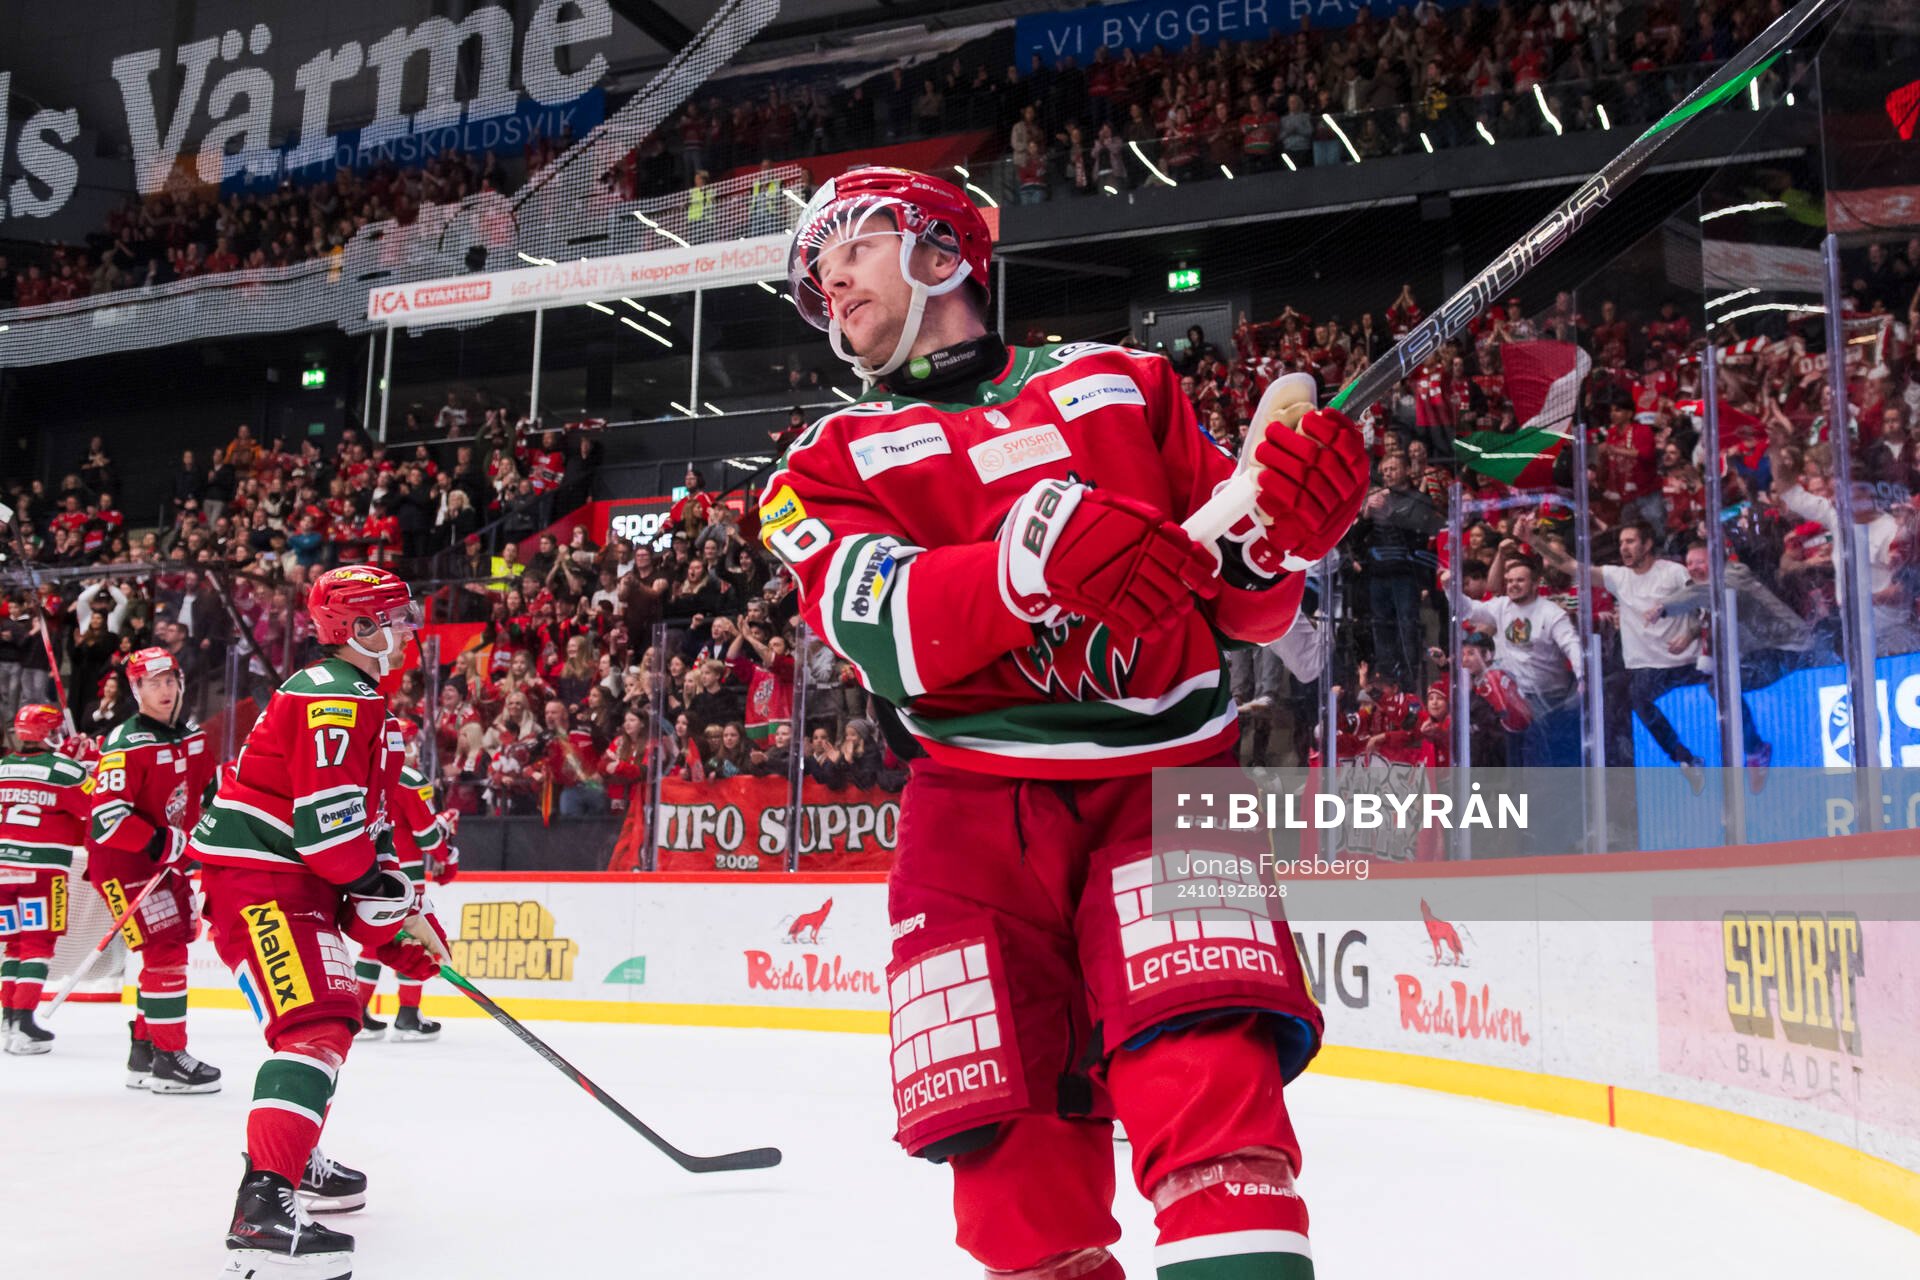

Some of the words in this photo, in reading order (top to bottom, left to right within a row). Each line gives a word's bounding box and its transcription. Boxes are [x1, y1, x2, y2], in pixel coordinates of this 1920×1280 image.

[1103, 0, 1268, 48] BYGGER
[112, 0, 613, 195] Värme
[372, 291, 410, 315] ICA
[1081, 387, 1138, 401] ACTEMIUM
[881, 435, 943, 454] Thermion
[1002, 430, 1059, 452] SYNSAM
[314, 728, 350, 768] 17
[96, 768, 126, 794] 38
[759, 803, 900, 854] SUPPO
[716, 854, 759, 869] 2002
[55, 878, 65, 928] Malux
[106, 882, 136, 944] Maux
[461, 901, 545, 940] EURO
[248, 907, 298, 1007] Malux
[450, 939, 570, 981] ACKPOT
[744, 950, 803, 990] Röda
[1126, 943, 1284, 992] Lerstenen.
[1294, 929, 1369, 1009] NG
[1723, 911, 1859, 1036] SPORT
[1394, 974, 1454, 1036] Röda
[897, 1058, 1007, 1118] Lerstenen.
[1736, 1043, 1863, 1101] BLADET
